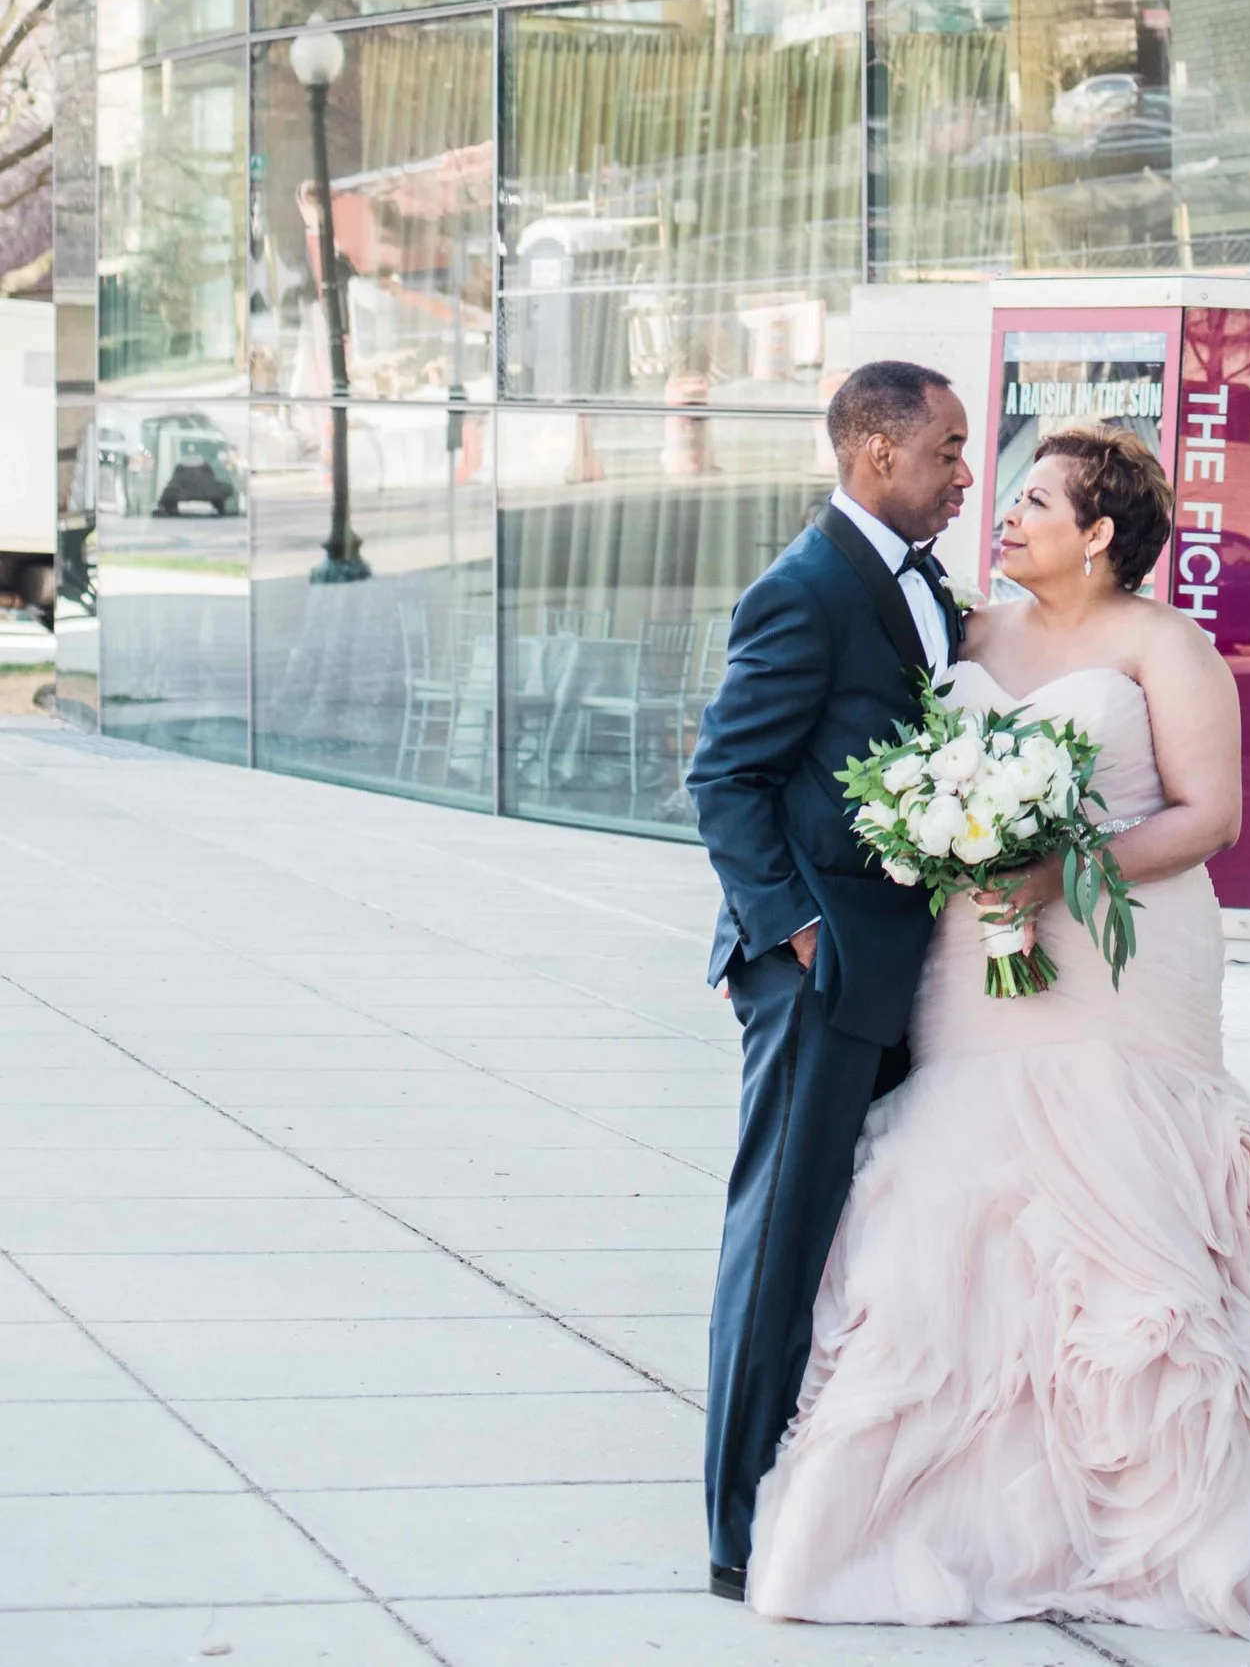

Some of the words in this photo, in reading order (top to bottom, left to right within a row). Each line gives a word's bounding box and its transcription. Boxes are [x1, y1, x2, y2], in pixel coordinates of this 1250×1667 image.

[1005, 381, 1017, 415] A
[1019, 381, 1072, 416] RAISIN
[1074, 381, 1094, 416] IN
[1095, 380, 1126, 417] THE
[1127, 381, 1163, 417] SUN
[1184, 384, 1229, 483] THE
[1178, 501, 1223, 646] FICH
